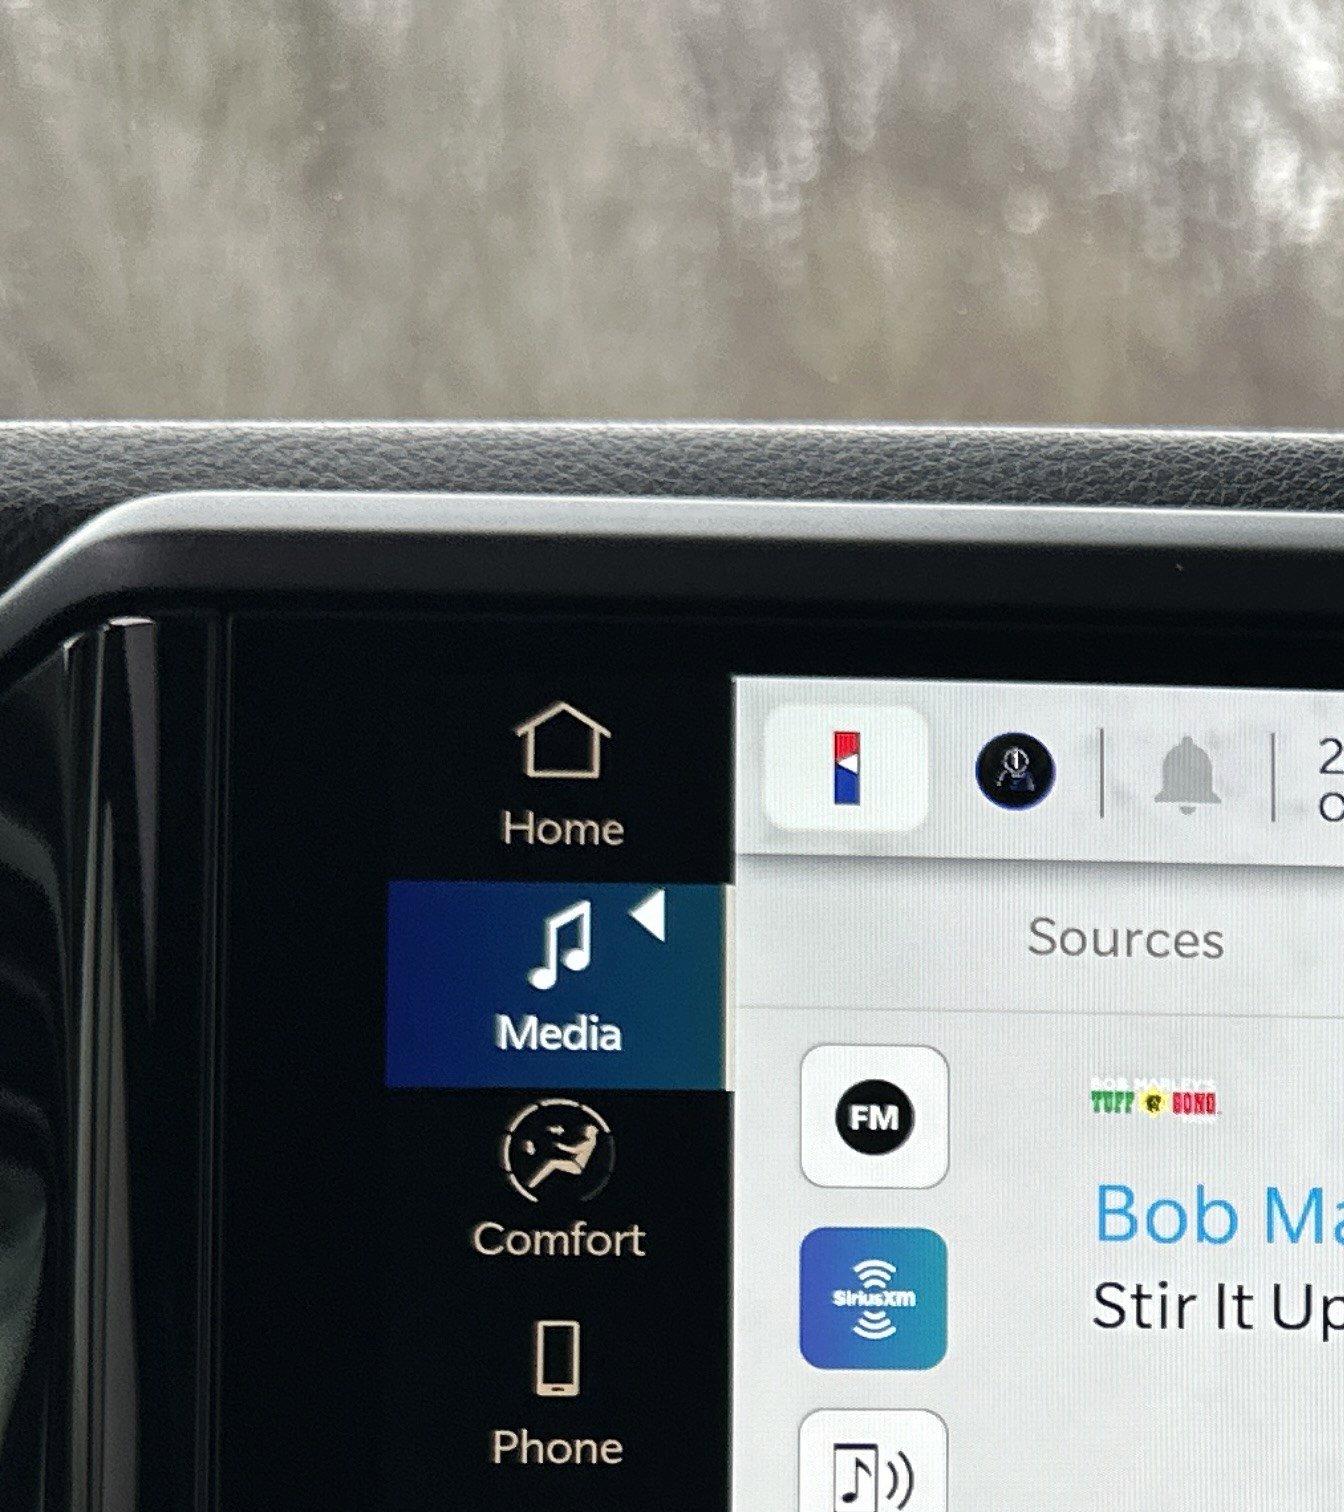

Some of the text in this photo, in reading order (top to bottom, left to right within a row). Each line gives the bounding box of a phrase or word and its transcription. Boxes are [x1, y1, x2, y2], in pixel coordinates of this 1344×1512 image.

[505, 811, 624, 845] Home
[1029, 917, 1223, 959] Sources
[497, 1014, 621, 1050] Media
[849, 1104, 899, 1131] FM
[1099, 1184, 1238, 1244] Bob
[474, 1221, 645, 1256] Comfort
[1094, 1281, 1197, 1329] Stir
[1218, 1283, 1253, 1329] It
[494, 1429, 623, 1464] Phone
